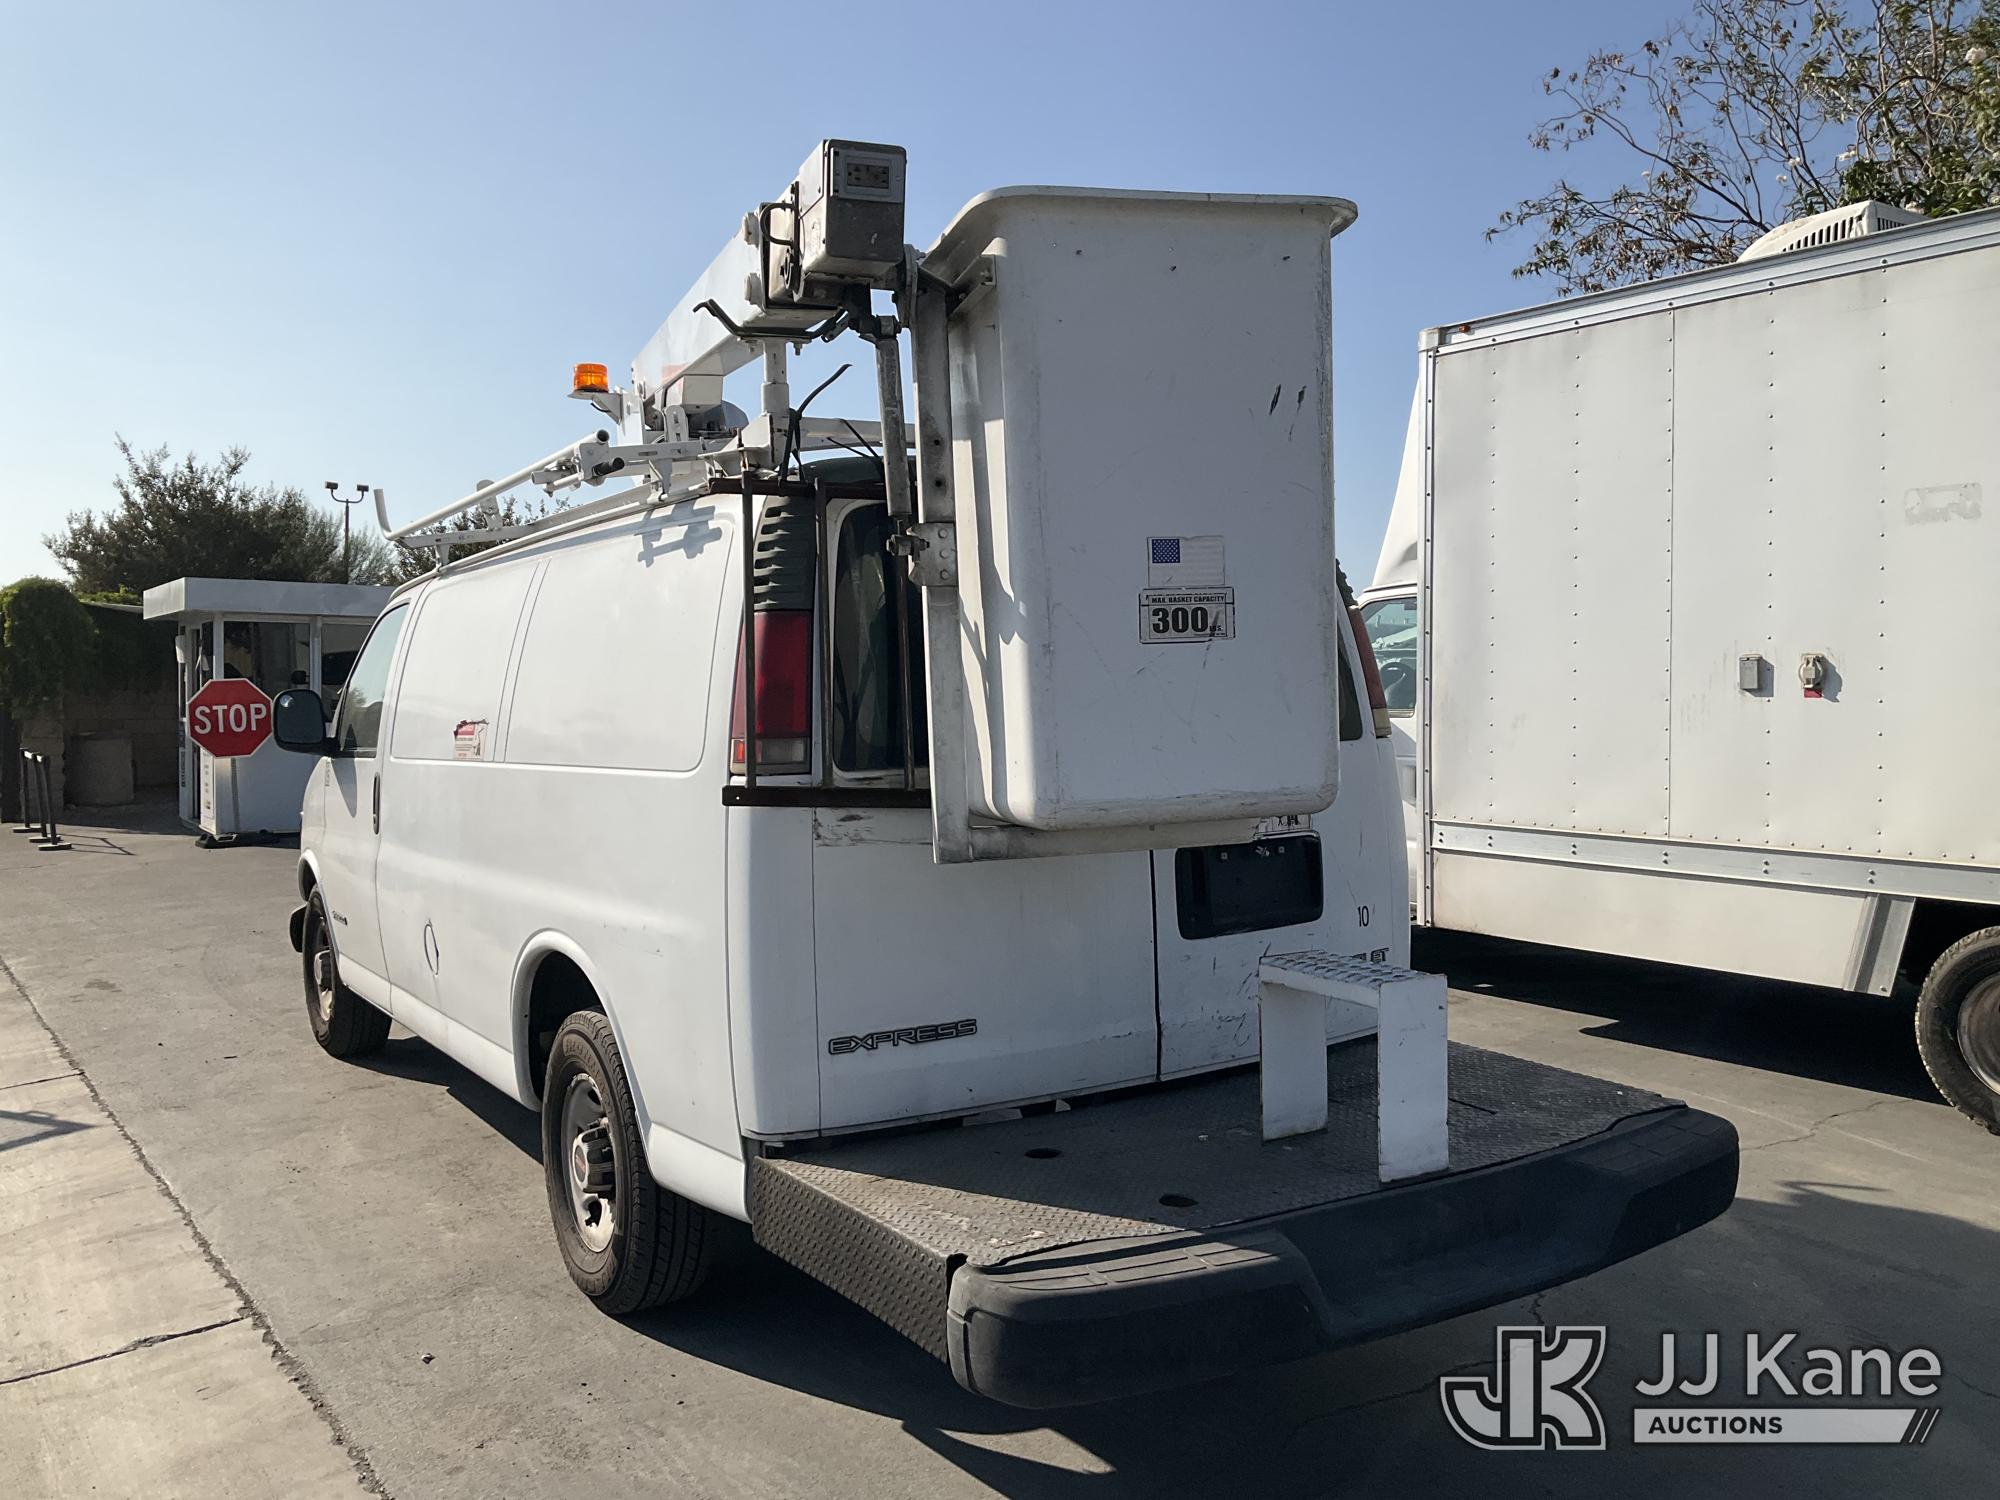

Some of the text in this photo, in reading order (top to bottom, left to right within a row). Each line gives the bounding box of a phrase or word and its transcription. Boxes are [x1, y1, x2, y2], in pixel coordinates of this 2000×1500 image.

[1151, 606, 1209, 634] 300
[194, 703, 267, 735] STOP
[1357, 905, 1370, 928] 10
[828, 1018, 978, 1056] EXPRESS
